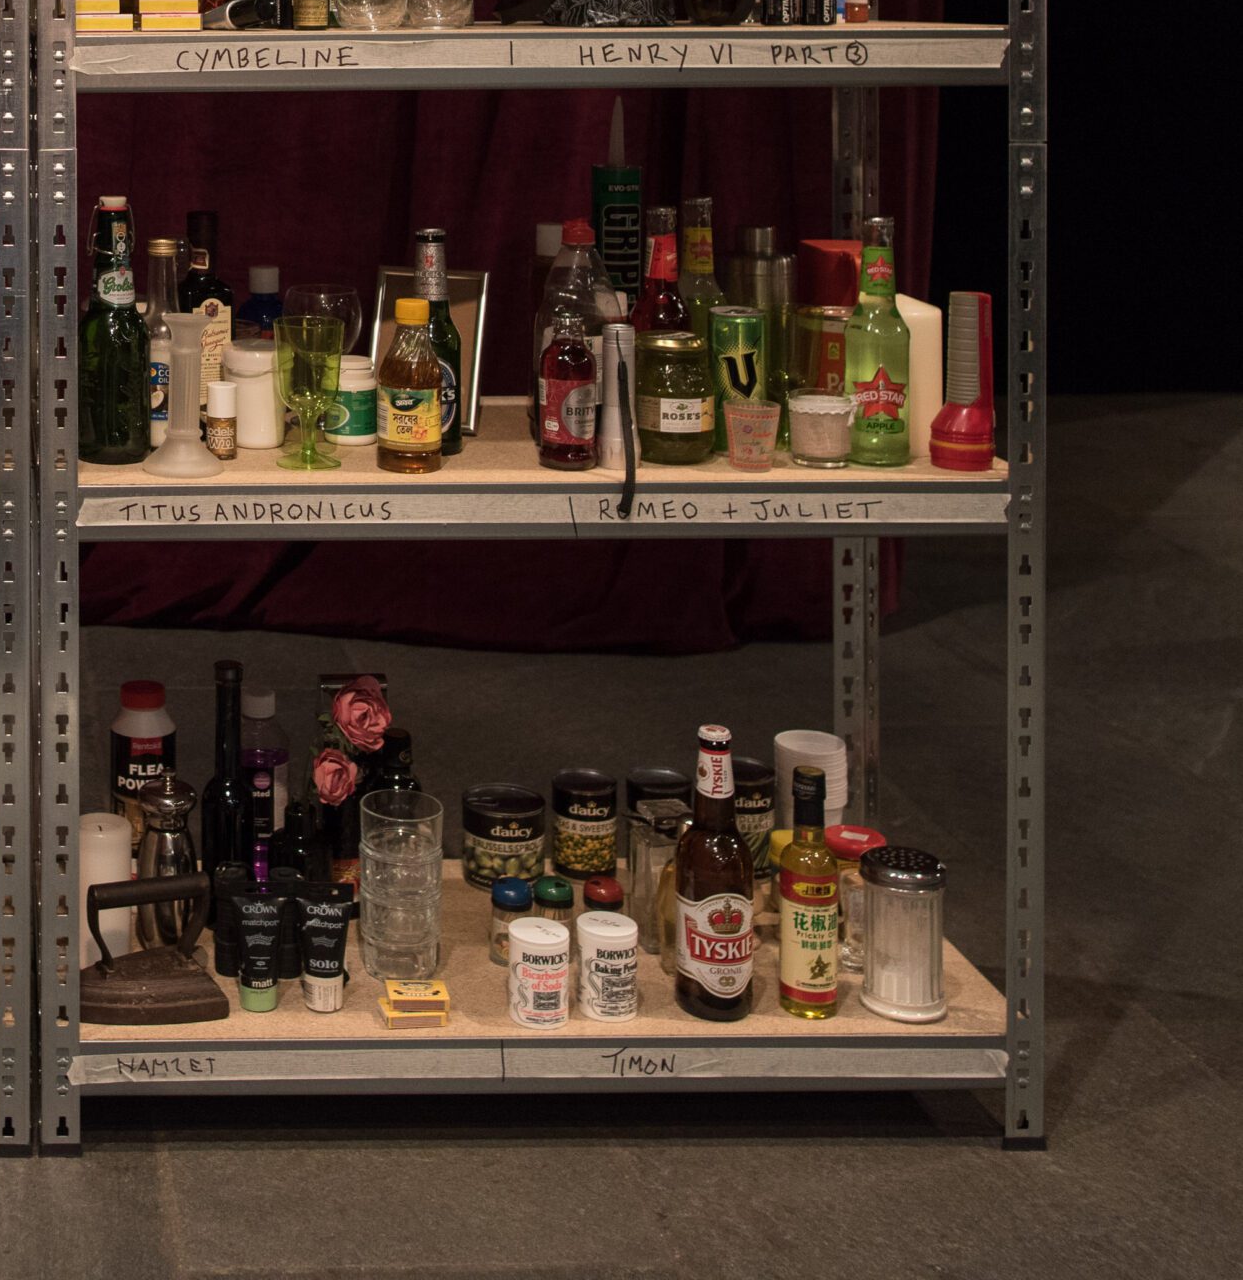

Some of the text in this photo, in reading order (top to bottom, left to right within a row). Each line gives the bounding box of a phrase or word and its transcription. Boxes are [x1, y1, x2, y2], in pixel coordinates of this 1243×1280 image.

[176, 46, 360, 73] CYMBELINE
[578, 42, 838, 73] HENRY VI PART
[867, 266, 879, 274] RED
[102, 276, 135, 295] Grols
[719, 350, 758, 400] V
[856, 390, 905, 406] RED STAR
[661, 412, 701, 422] ROSE'S
[207, 427, 235, 437] odels
[866, 421, 895, 430] APPLE
[118, 500, 392, 522] TITUS ANDRONICUS
[749, 499, 883, 522] JULIET
[128, 762, 165, 776] FLEA
[711, 756, 723, 796] TYSKIE
[568, 803, 611, 818] d'aucy
[734, 797, 771, 810] d'aucy
[490, 825, 533, 839] d'aucy
[242, 905, 278, 916] CROWN
[306, 903, 343, 917] CROWN
[241, 918, 279, 928] matchpot
[796, 930, 825, 940] Prickly
[690, 933, 752, 961] TYSKIE
[309, 958, 339, 970] solo
[594, 963, 622, 976] Baking
[251, 978, 273, 988] matt
[531, 980, 542, 990] of
[601, 1046, 676, 1077] TIMON
